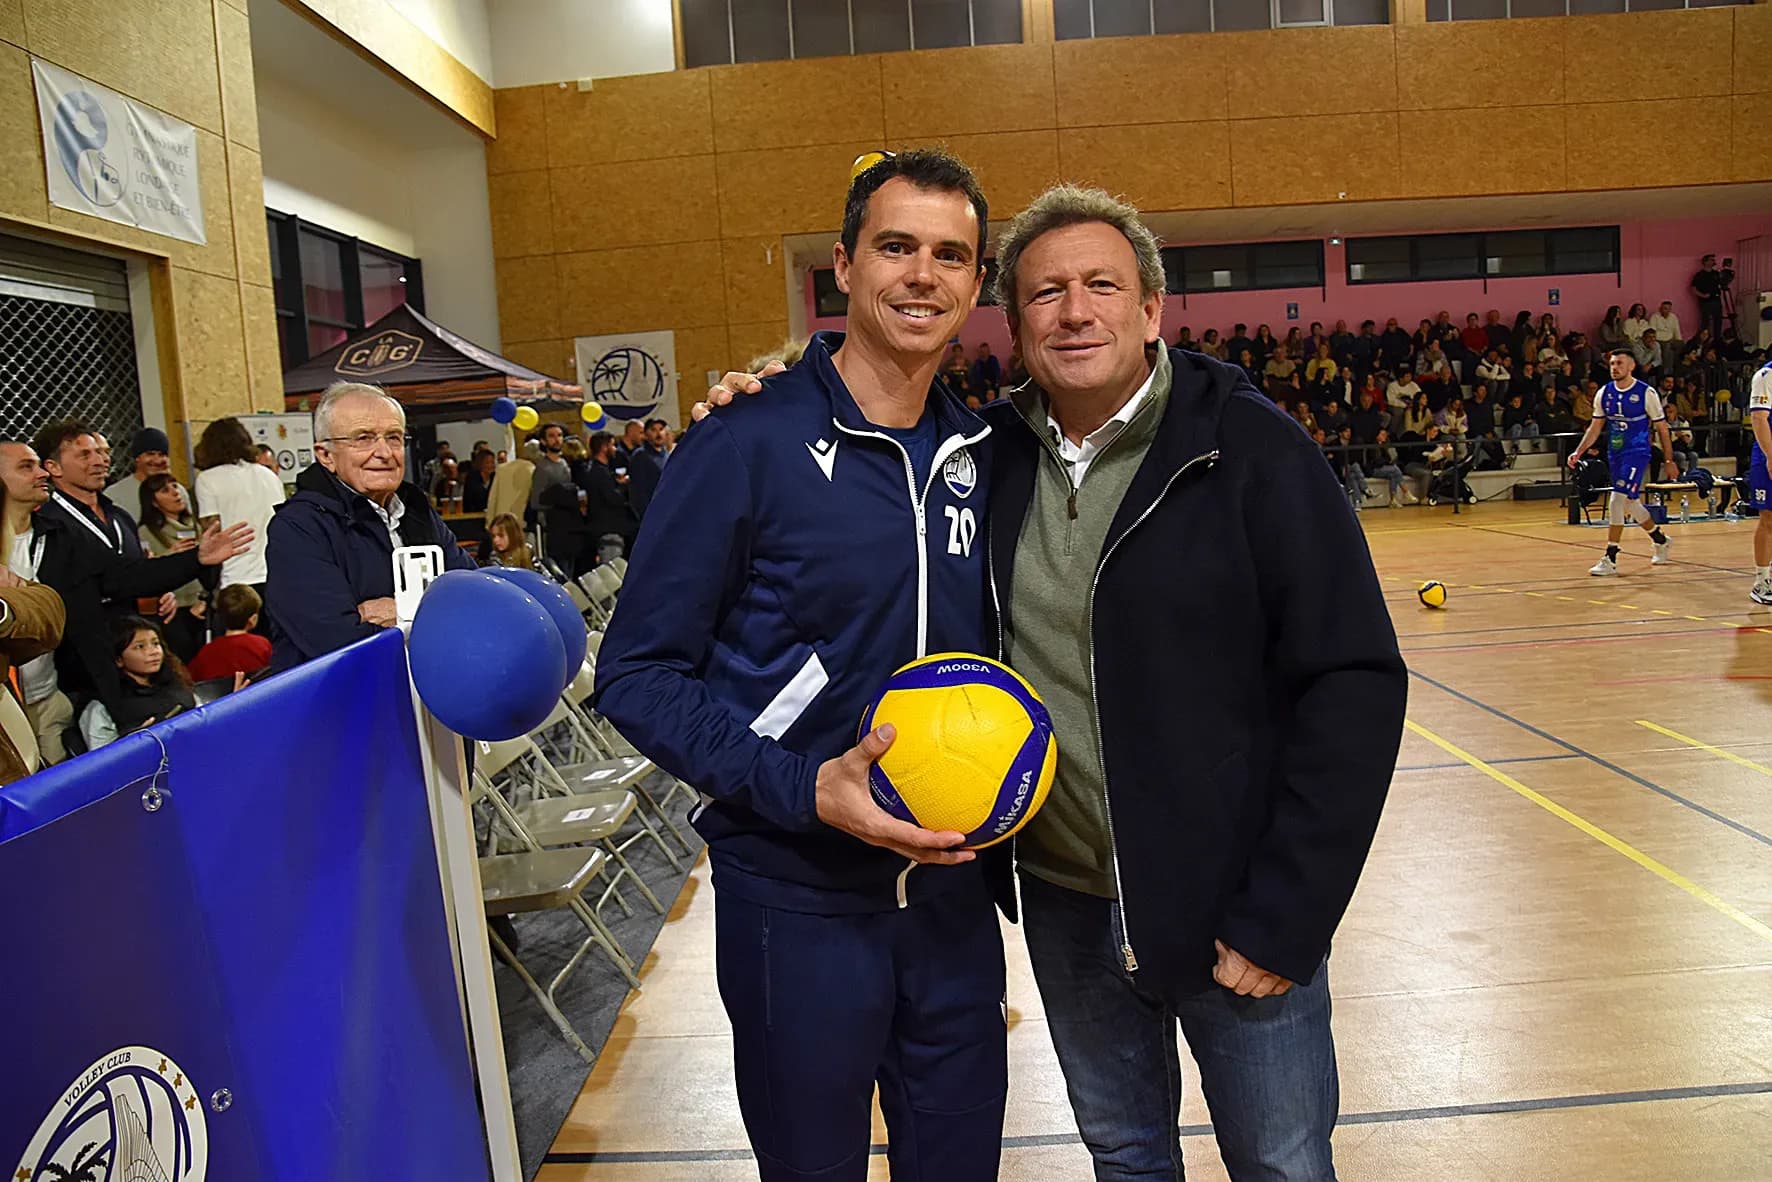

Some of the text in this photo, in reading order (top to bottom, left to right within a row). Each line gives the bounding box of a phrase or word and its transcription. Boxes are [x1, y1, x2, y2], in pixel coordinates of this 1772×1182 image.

[1614, 401, 1625, 417] 1
[1628, 467, 1637, 480] 1
[944, 504, 977, 558] 20
[936, 663, 991, 675] V300W
[63, 1051, 132, 1108] VOLLEY CLUB
